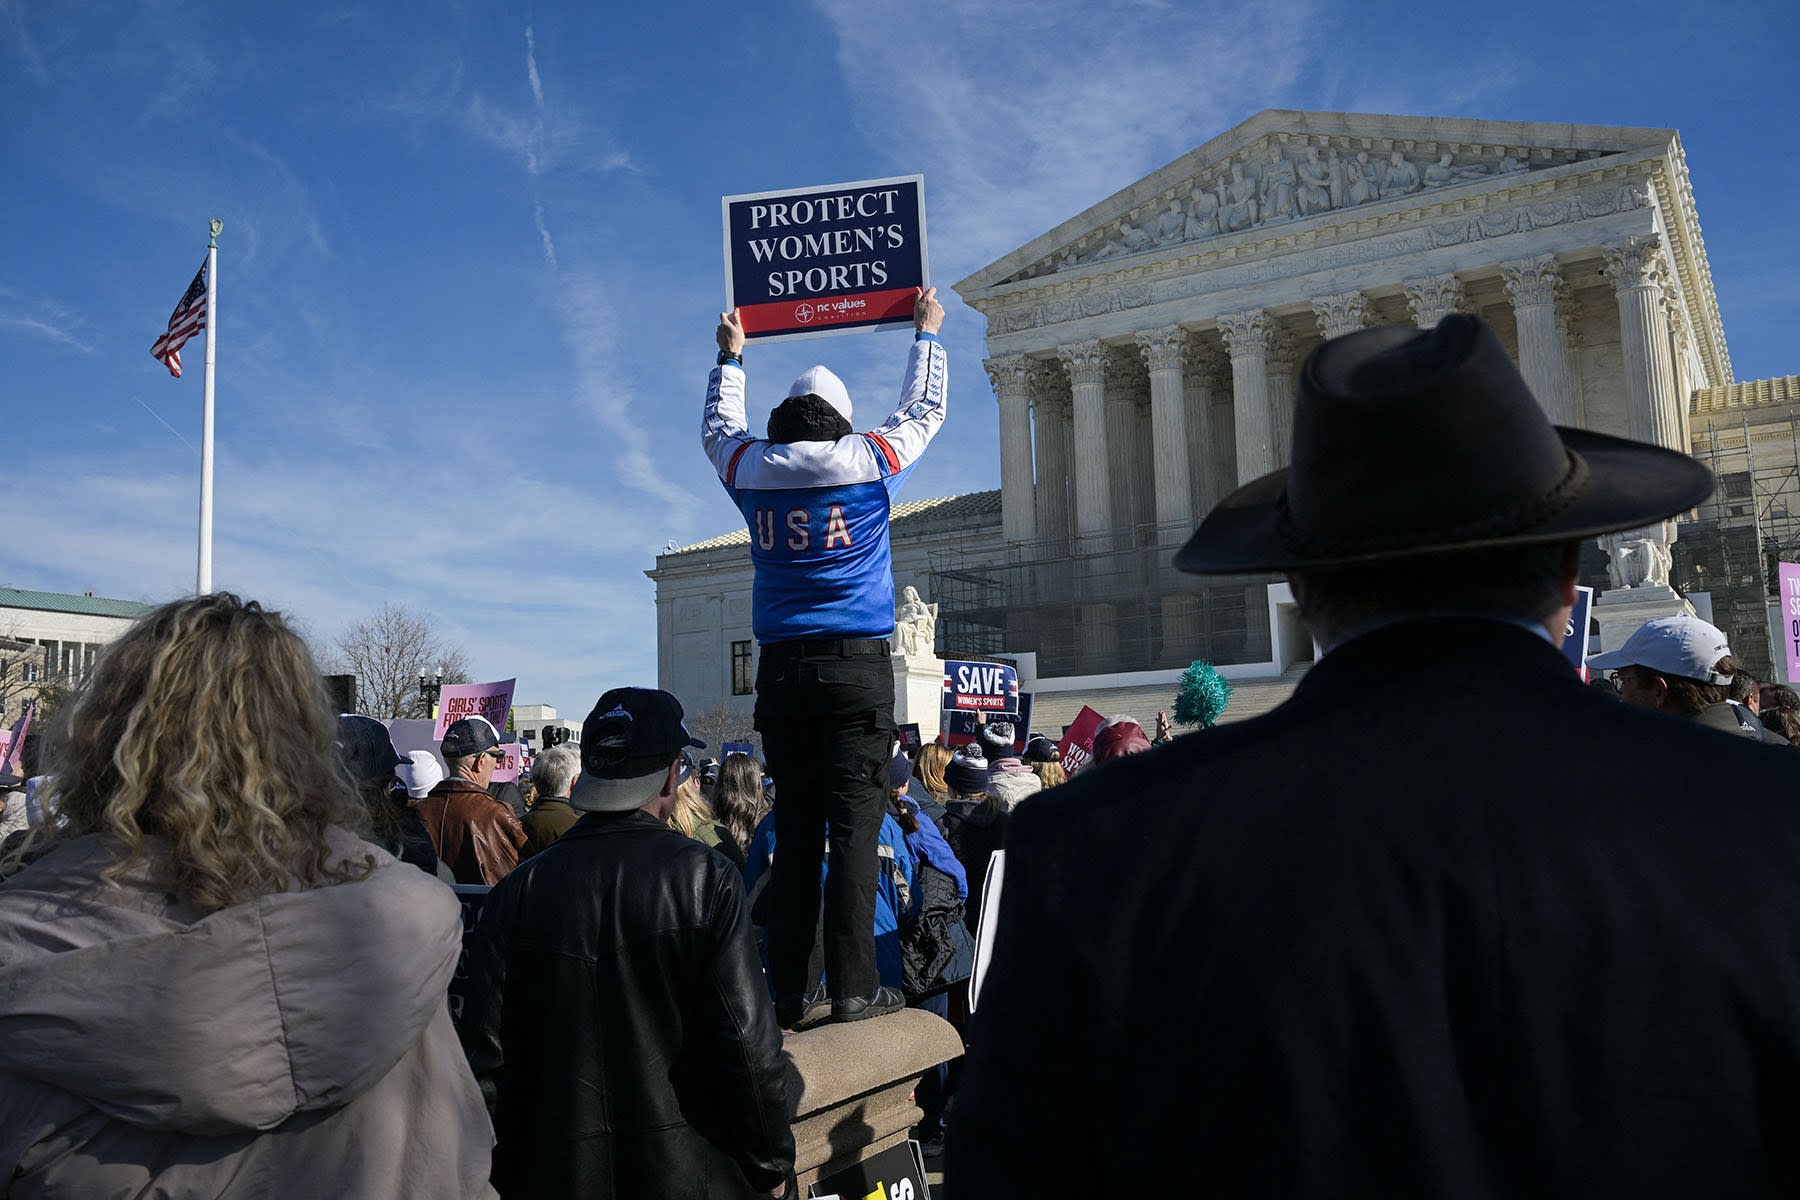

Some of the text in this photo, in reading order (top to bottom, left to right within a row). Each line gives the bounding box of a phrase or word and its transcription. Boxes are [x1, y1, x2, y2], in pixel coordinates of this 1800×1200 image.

[750, 190, 899, 230] PROTECT
[748, 223, 904, 264] WOMEN'S
[768, 260, 888, 297] SPORTS
[817, 298, 866, 312] nc values
[756, 506, 853, 551] USA
[957, 665, 1004, 695] SAVE
[448, 693, 508, 713] GIRLS' SPORTS
[957, 695, 1004, 706] WOMEN'S SPORTS
